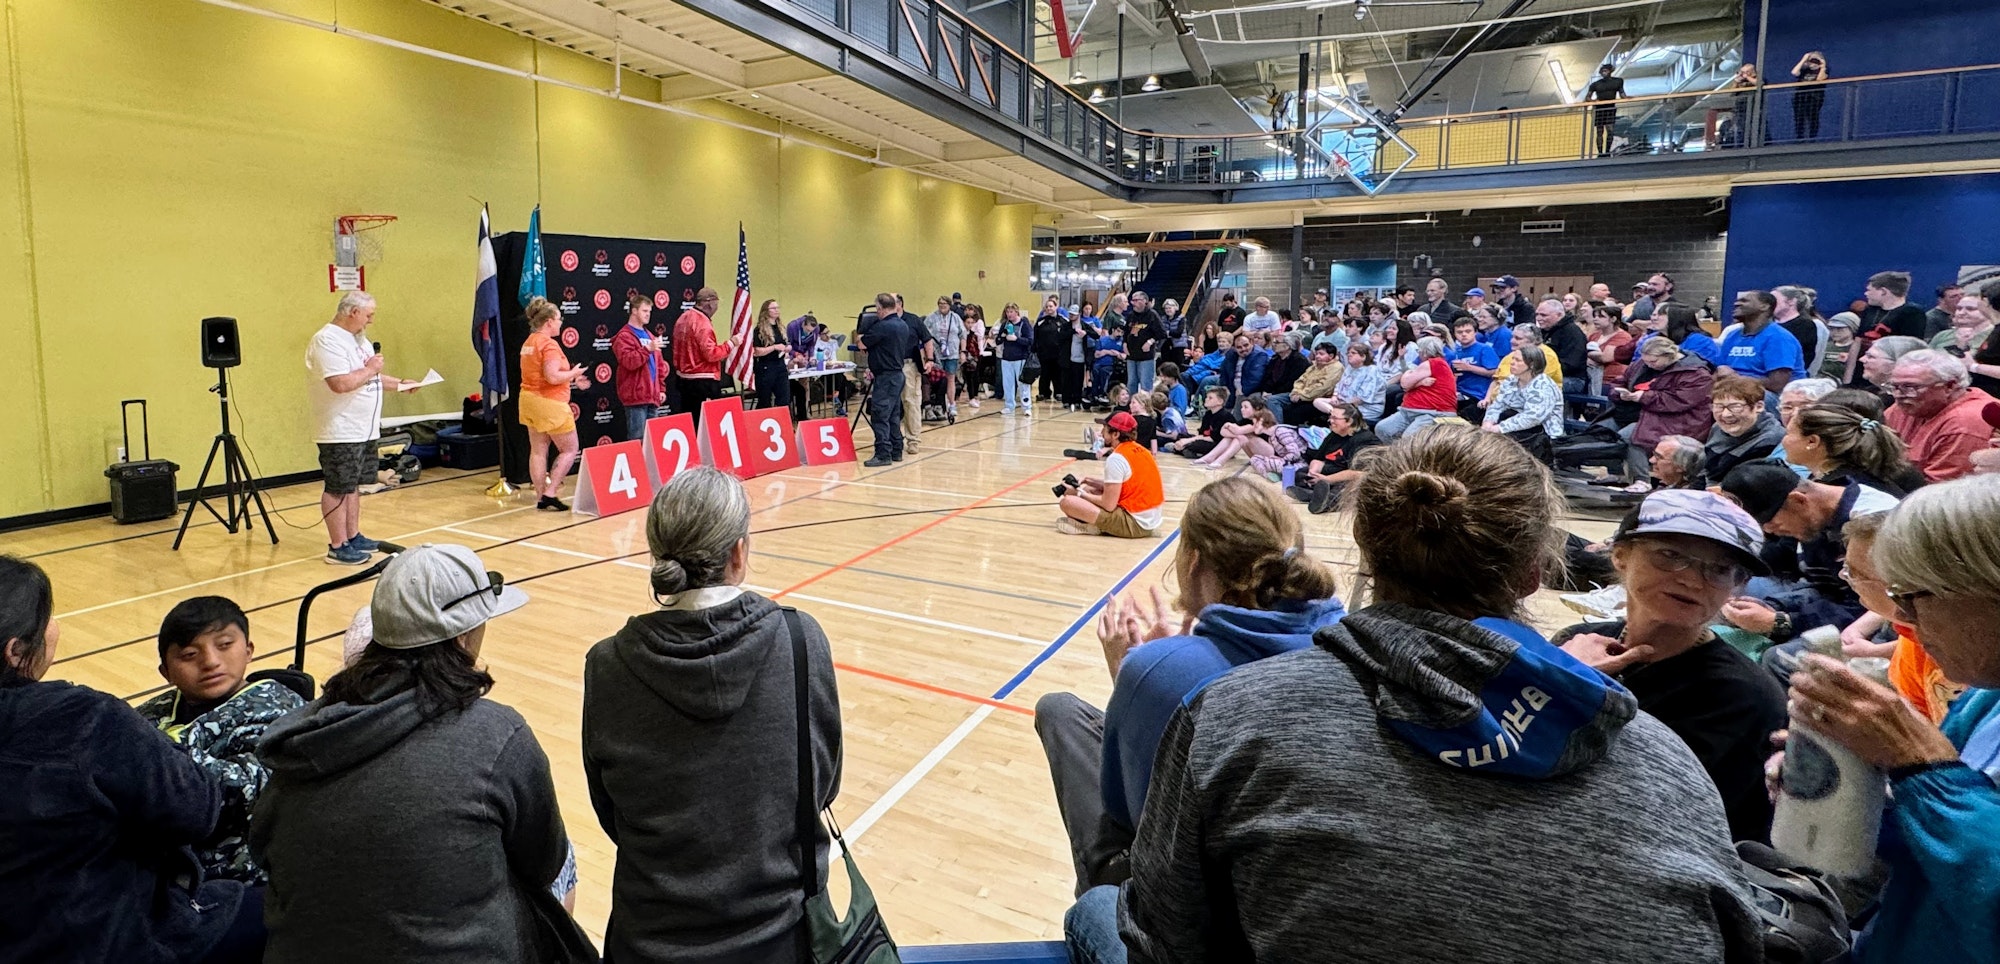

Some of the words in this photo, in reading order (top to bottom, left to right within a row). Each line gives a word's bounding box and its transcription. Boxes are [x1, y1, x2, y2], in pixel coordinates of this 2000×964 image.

[662, 428, 690, 482] 2
[720, 411, 742, 468] 1
[759, 418, 787, 462] 3
[819, 425, 840, 457] 5
[608, 452, 638, 499] 4
